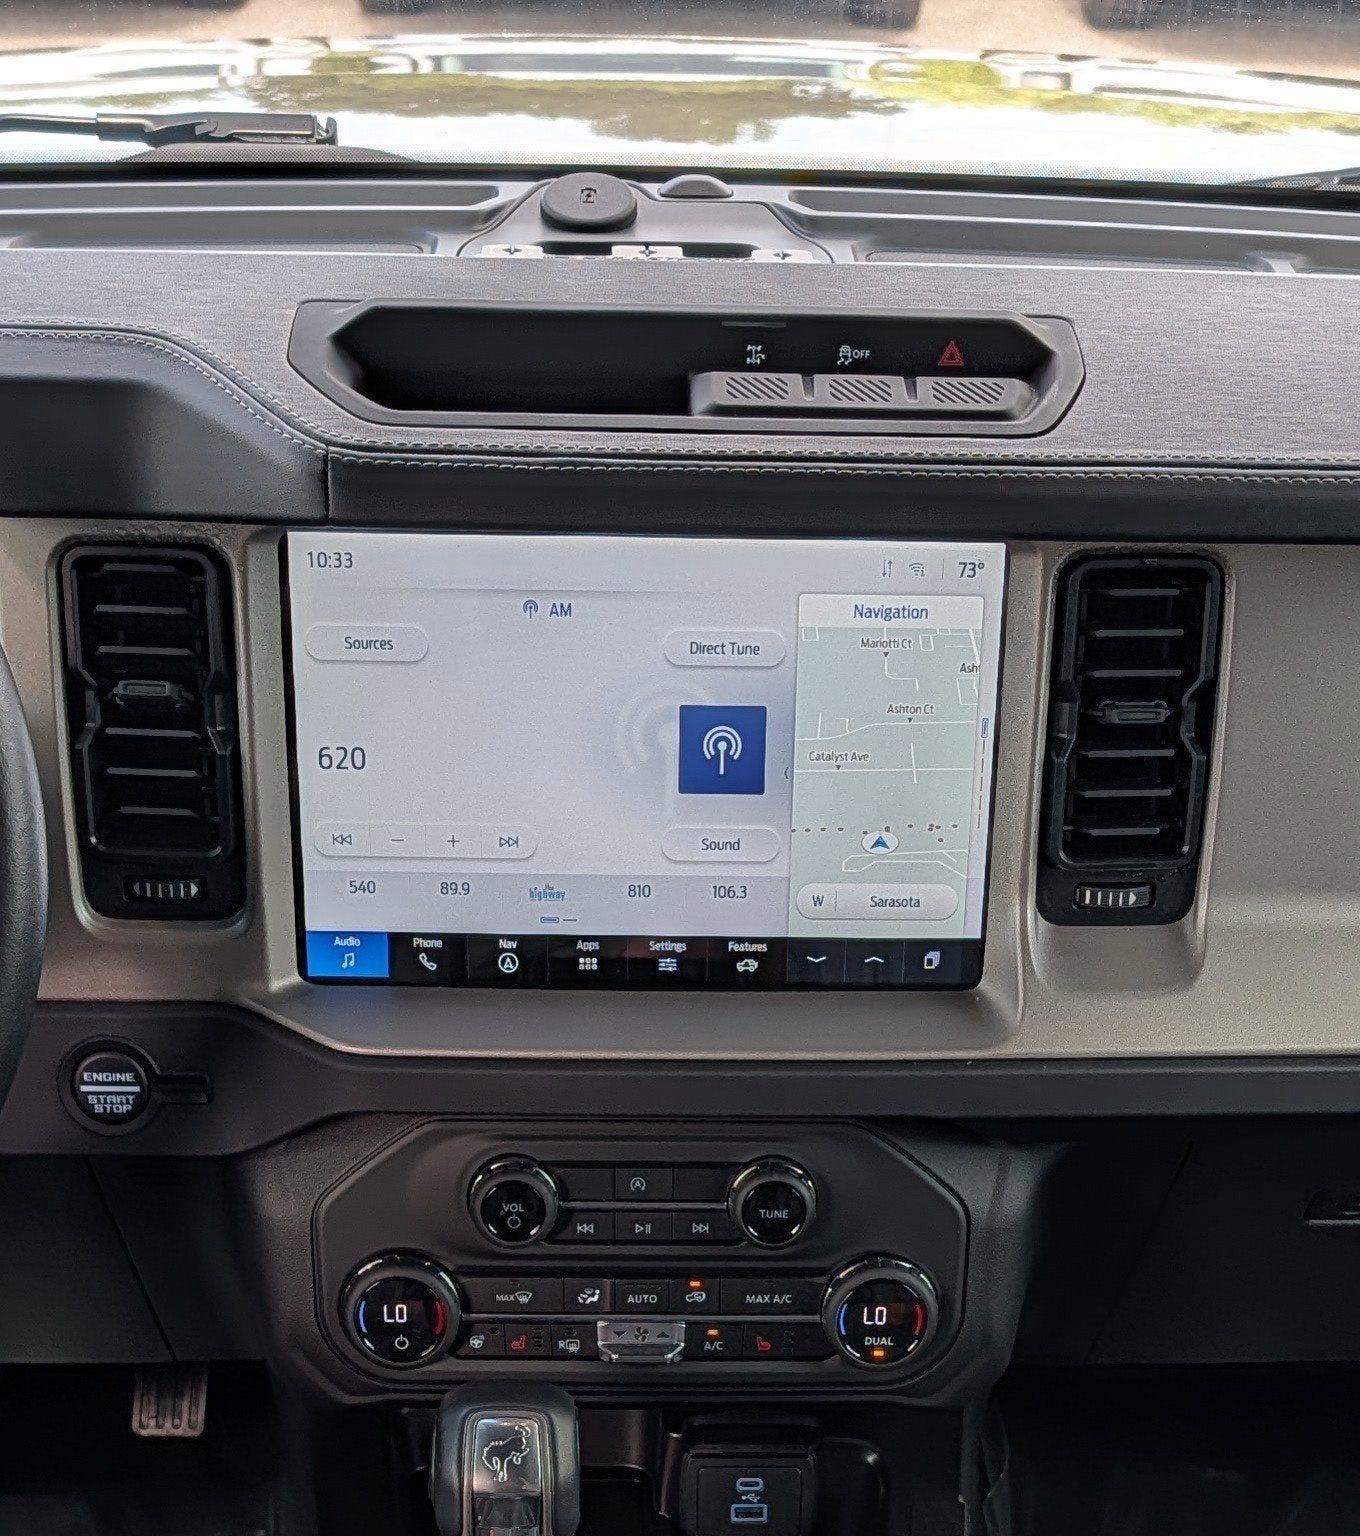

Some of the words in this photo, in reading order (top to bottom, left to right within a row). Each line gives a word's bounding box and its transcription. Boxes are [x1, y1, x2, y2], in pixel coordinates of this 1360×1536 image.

[852, 349, 871, 359] OFF
[306, 551, 354, 569] 10:33
[549, 602, 573, 618] AM
[853, 603, 929, 621] Navigation
[344, 636, 394, 651] Sources
[690, 641, 726, 656] Direct
[729, 641, 761, 656] Tune
[860, 637, 900, 650] Mariotti
[901, 637, 913, 650] Ct
[887, 703, 921, 715] Ashton
[922, 703, 935, 715] Ct
[317, 746, 367, 771] 620
[808, 750, 849, 764] Catalyst
[850, 751, 870, 763] Ave
[700, 838, 741, 852] Sound
[348, 880, 377, 895] 540
[439, 881, 471, 896] 89.9
[627, 884, 652, 899] 810
[712, 885, 748, 900] 106.3
[811, 895, 825, 908] W
[869, 895, 921, 909] Sarasota
[334, 936, 361, 948] Audio
[412, 936, 443, 949] Phone
[499, 938, 518, 949] Nav
[576, 940, 600, 952] Apps
[649, 940, 687, 953] Settings
[728, 940, 768, 953] Features
[83, 1072, 136, 1083] ENGINE
[87, 1094, 136, 1104] START
[94, 1104, 132, 1114] STOP
[502, 1202, 525, 1213] VOL
[759, 1209, 789, 1219] TUNE
[495, 1293, 515, 1302] MAX
[627, 1294, 658, 1304] AUTO
[745, 1294, 771, 1304] MAX
[772, 1294, 793, 1305] A/C
[383, 1303, 408, 1323] LO
[863, 1306, 887, 1325] LO
[704, 1341, 724, 1351] A/C
[864, 1336, 894, 1346] DUAL
